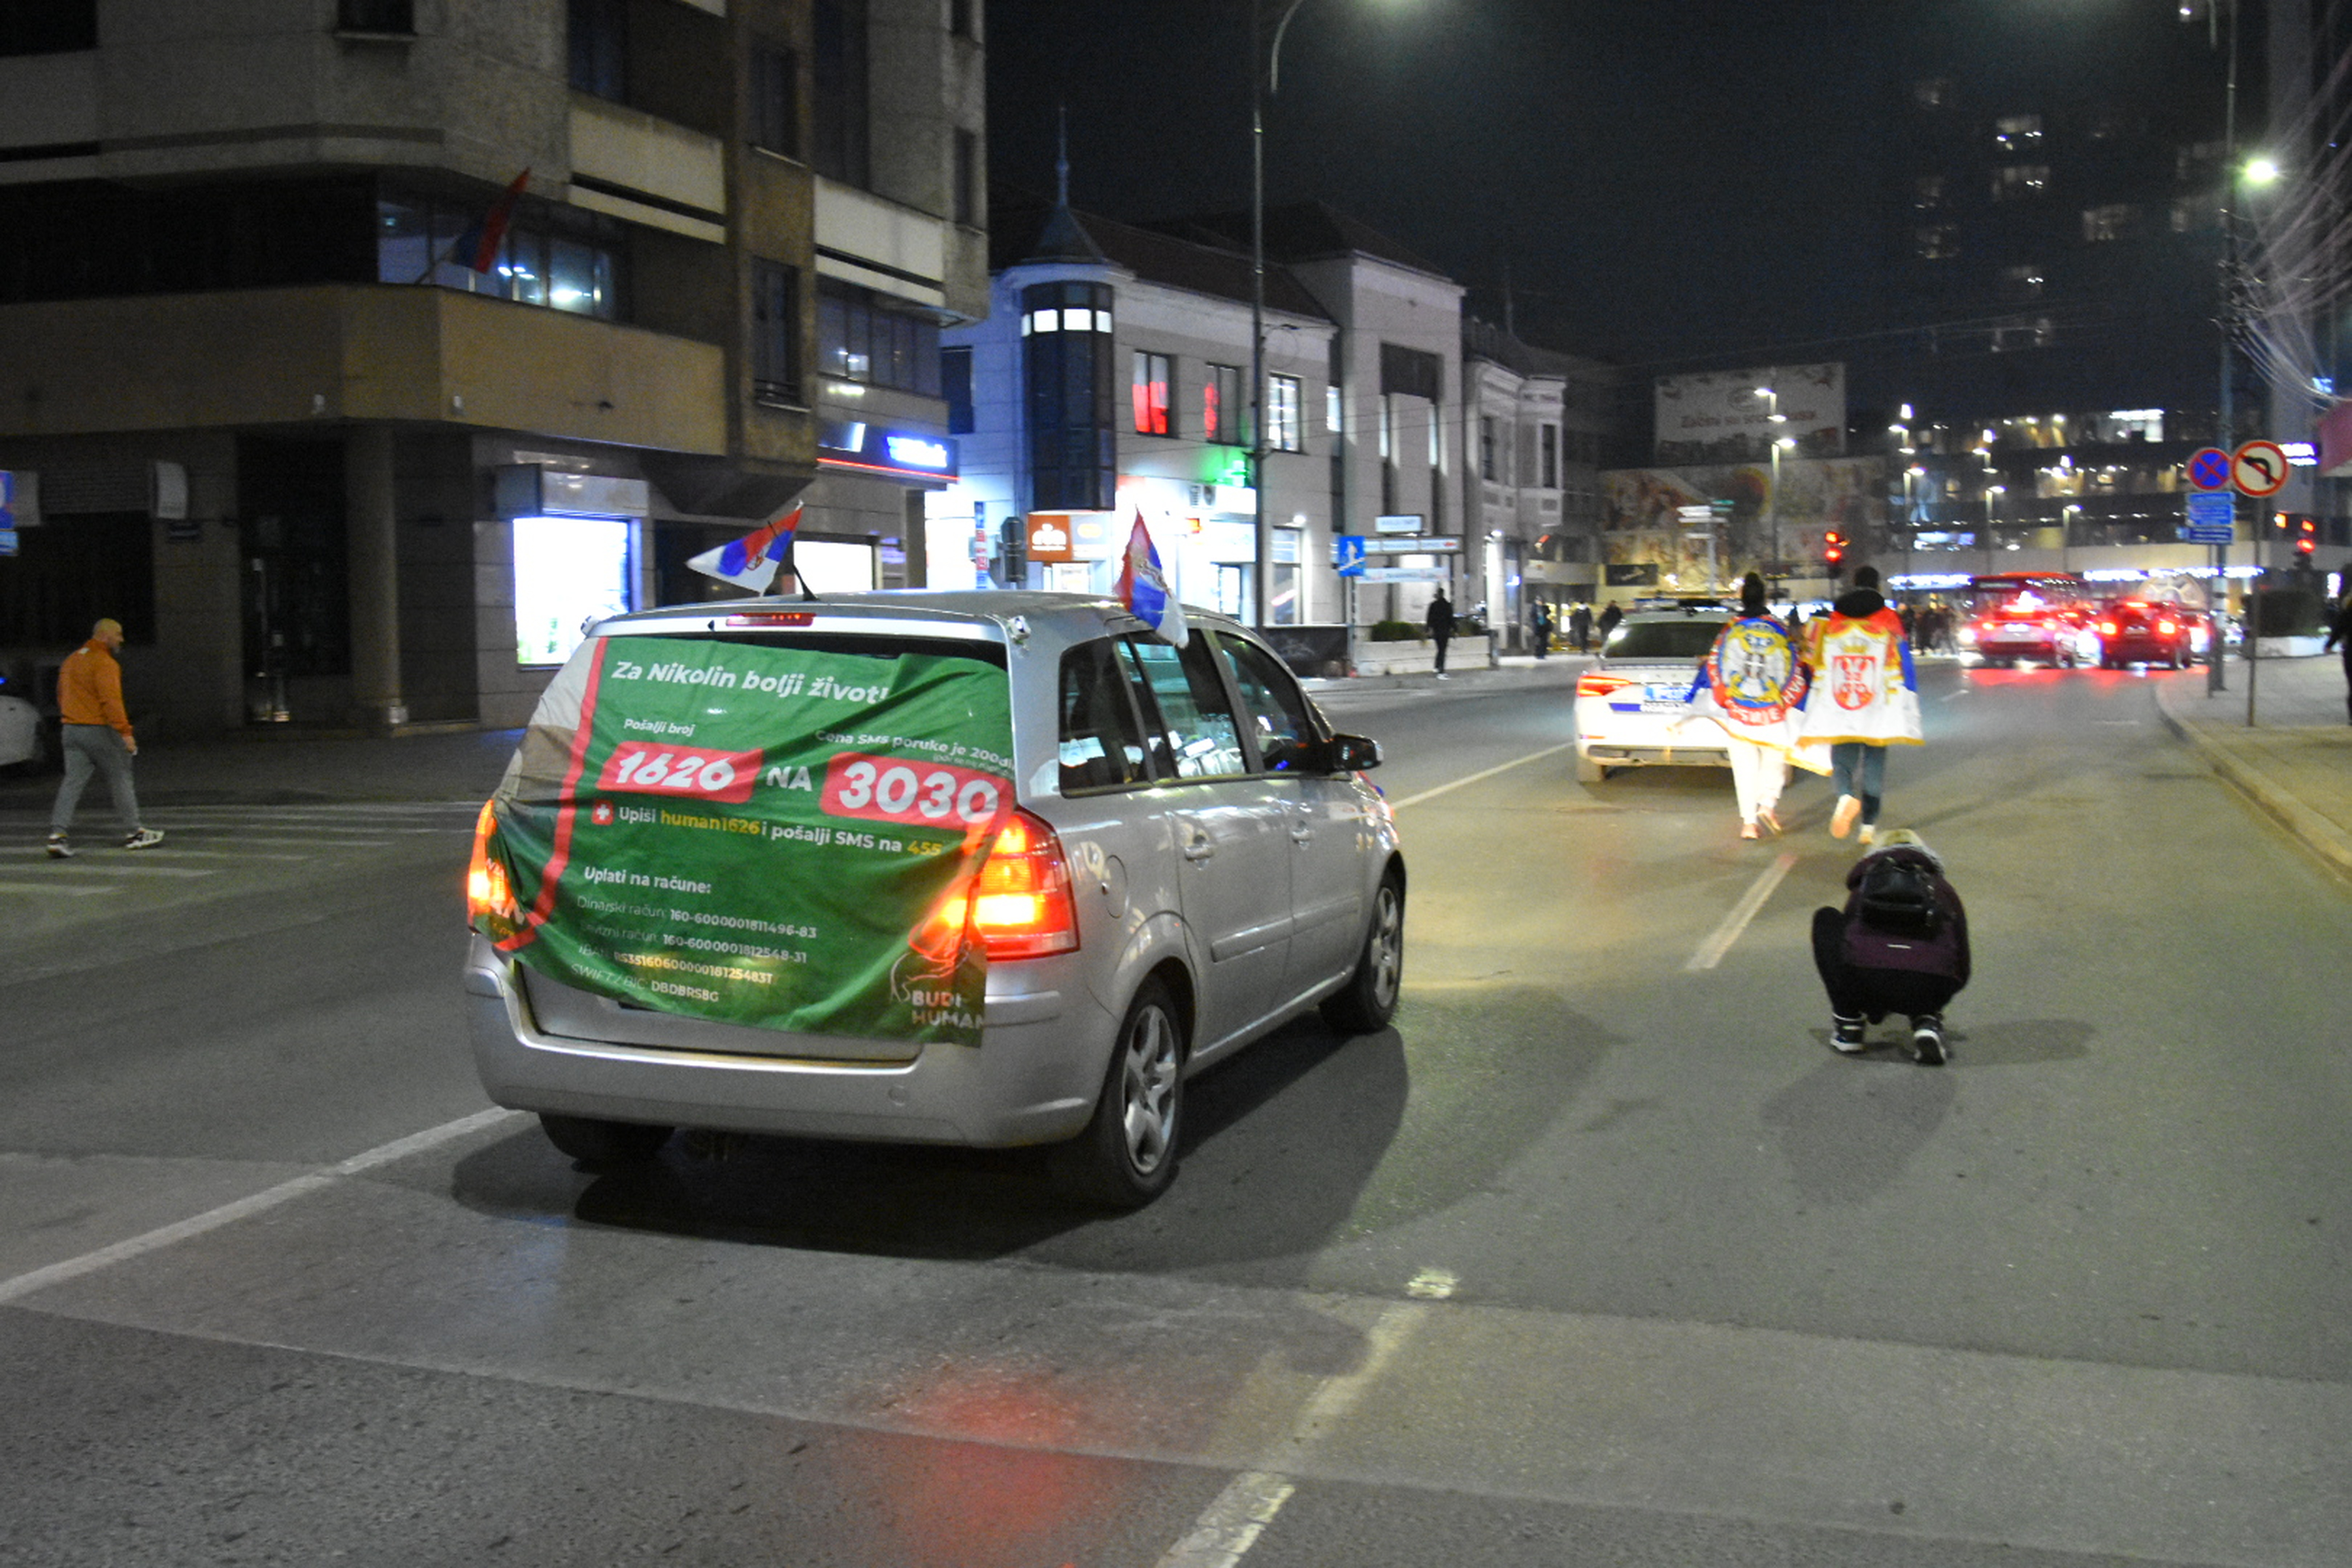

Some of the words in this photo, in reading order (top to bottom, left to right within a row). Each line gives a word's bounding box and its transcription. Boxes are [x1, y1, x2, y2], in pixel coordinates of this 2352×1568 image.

[611, 661, 642, 680] Za
[647, 662, 736, 687] Nikolin
[742, 670, 805, 697] bolji
[808, 676, 889, 704] život!
[624, 718, 667, 733] Pošalji
[668, 723, 696, 737] broj
[816, 730, 853, 744] Cena
[857, 734, 890, 745] SMS
[892, 736, 949, 753] poruke
[950, 742, 966, 756] je
[970, 747, 1015, 770] 200di
[616, 751, 735, 791] 1626
[766, 766, 812, 791] NA
[839, 760, 999, 823] 3030
[661, 810, 760, 834] human1626
[762, 821, 767, 835] i
[771, 825, 831, 845] pošalji
[835, 831, 874, 848] SMS
[879, 839, 902, 852] na
[907, 840, 943, 856] 455
[584, 866, 627, 885] Uplati
[630, 874, 650, 886] na
[654, 875, 711, 894] račune:
[577, 896, 627, 913] Dinarski
[651, 981, 719, 1002] DBDBRSBG
[912, 990, 962, 1007] BUDI
